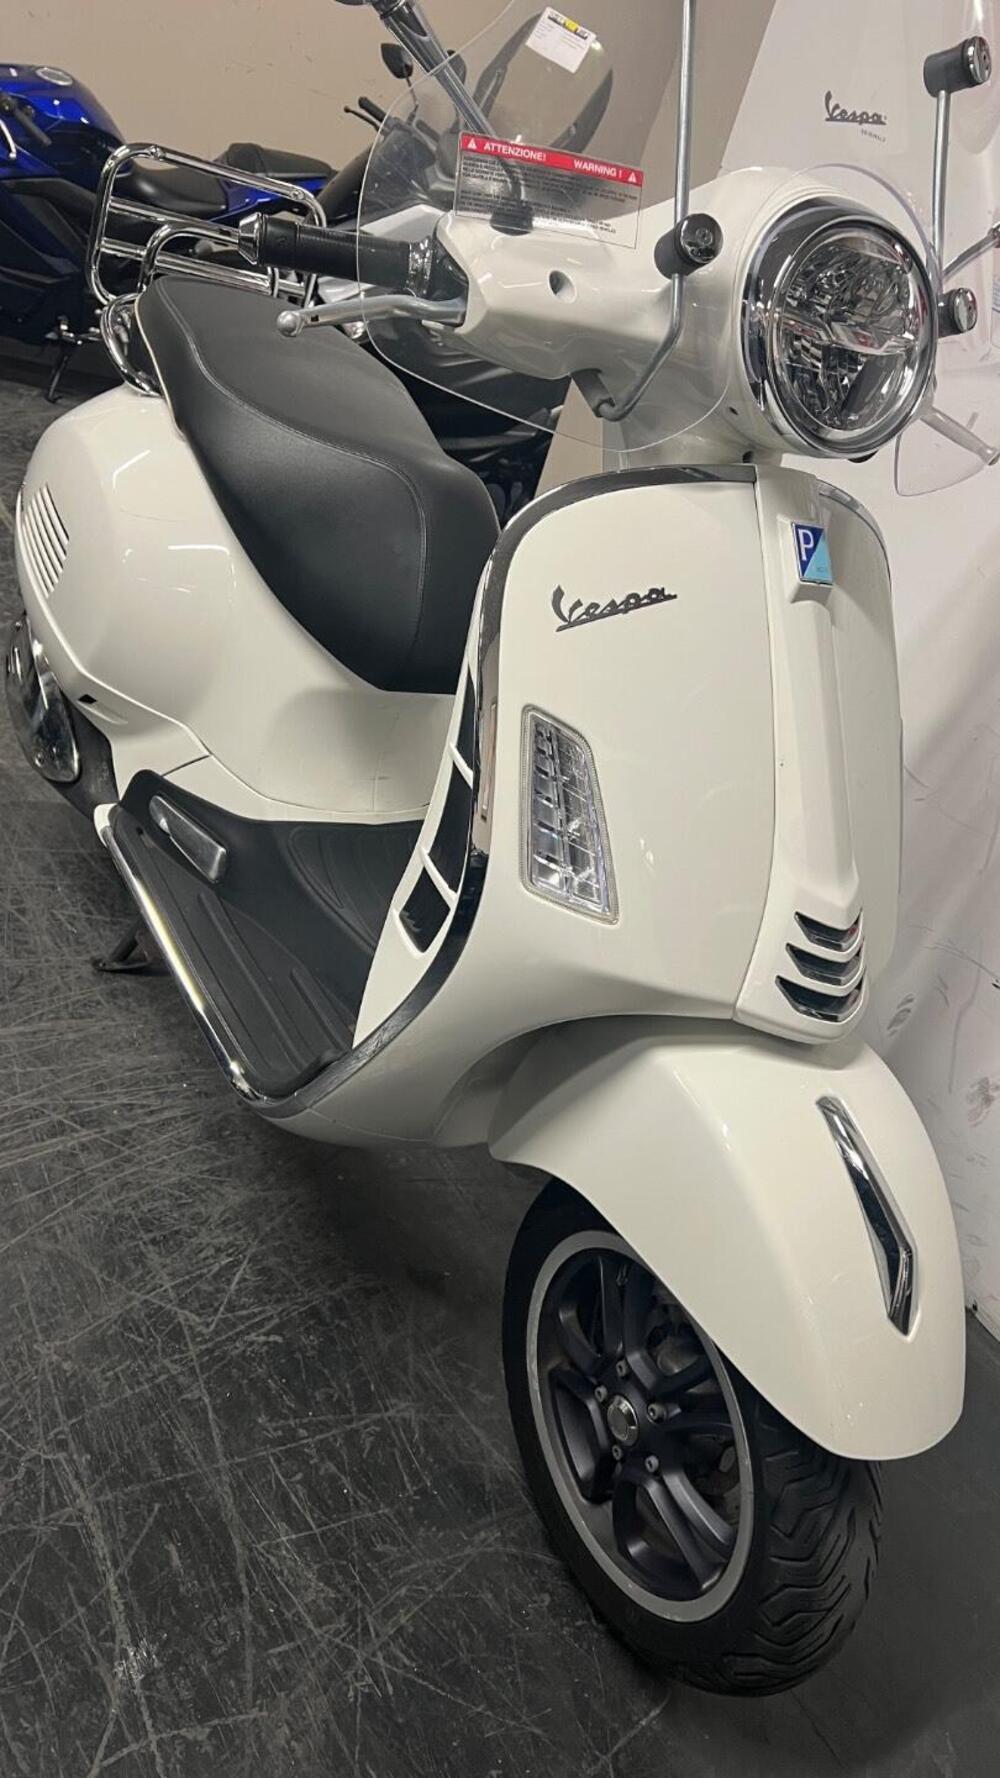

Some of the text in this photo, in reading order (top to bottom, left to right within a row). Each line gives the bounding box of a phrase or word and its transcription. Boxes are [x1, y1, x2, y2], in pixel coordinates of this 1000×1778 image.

[825, 90, 887, 126] Vespa
[484, 142, 546, 161] ATTENZIONE!
[798, 528, 814, 561] P
[552, 585, 677, 632] Vespa
